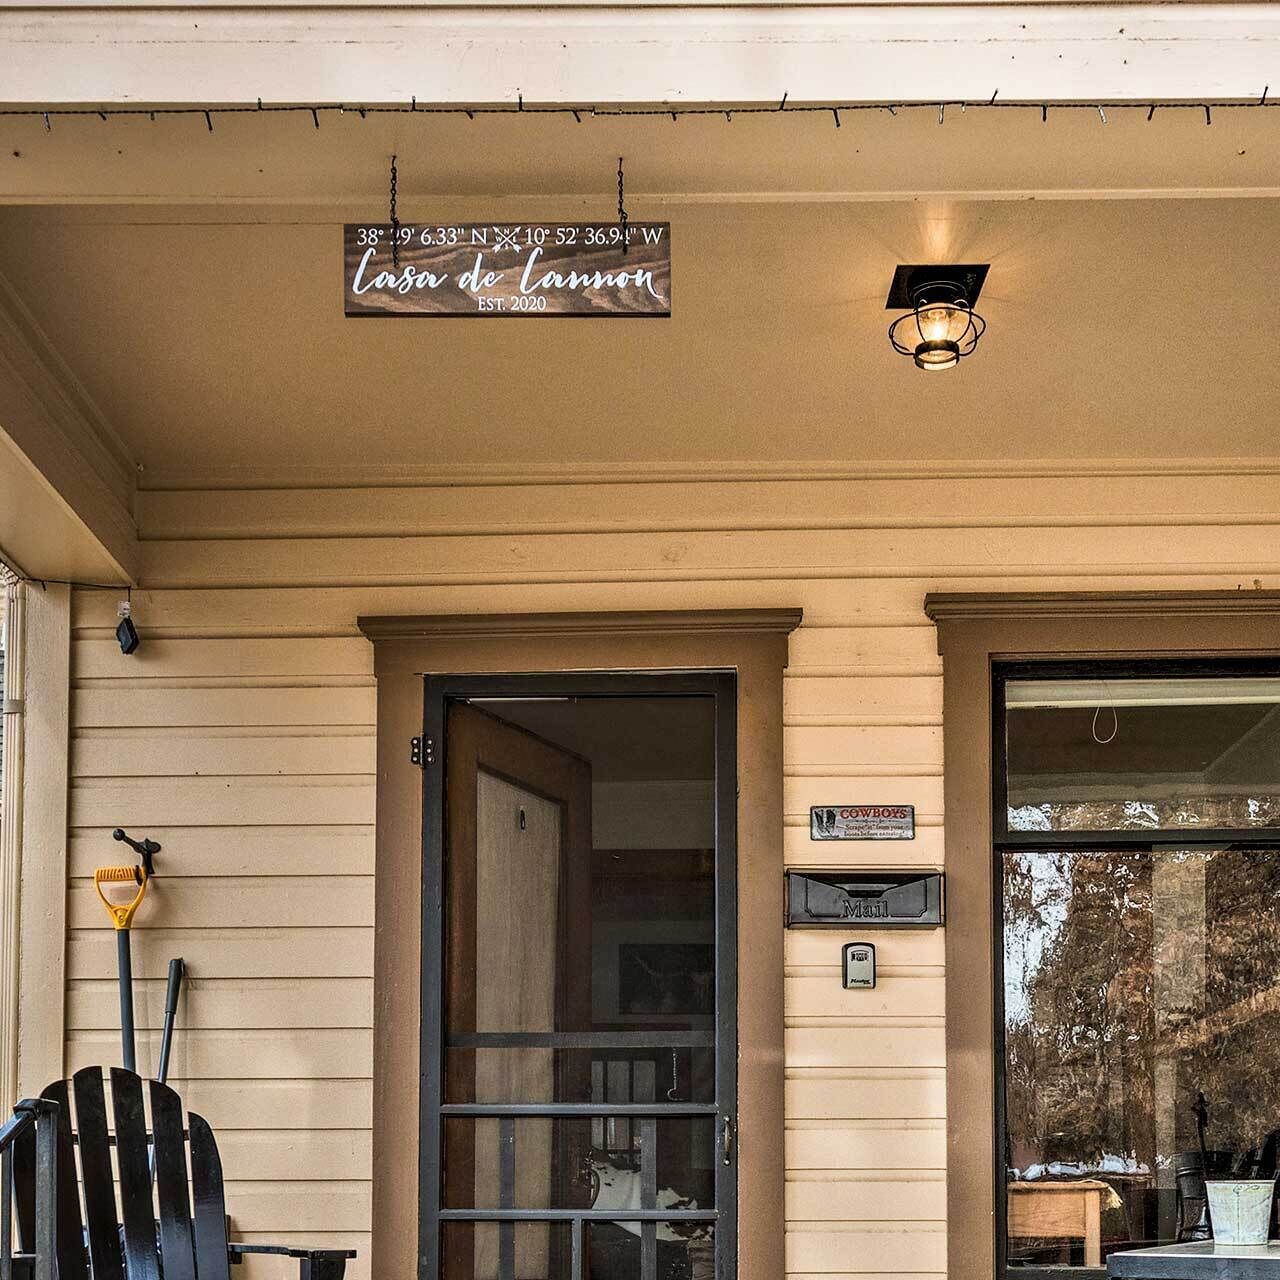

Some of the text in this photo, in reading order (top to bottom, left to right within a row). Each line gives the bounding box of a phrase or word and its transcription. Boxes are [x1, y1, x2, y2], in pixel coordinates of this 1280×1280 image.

[471, 228, 488, 245] N
[641, 227, 664, 245] W
[458, 252, 505, 293] de
[477, 295, 547, 312] EST. 2020
[839, 807, 907, 819] COWBOYS
[841, 900, 888, 917] Mail
